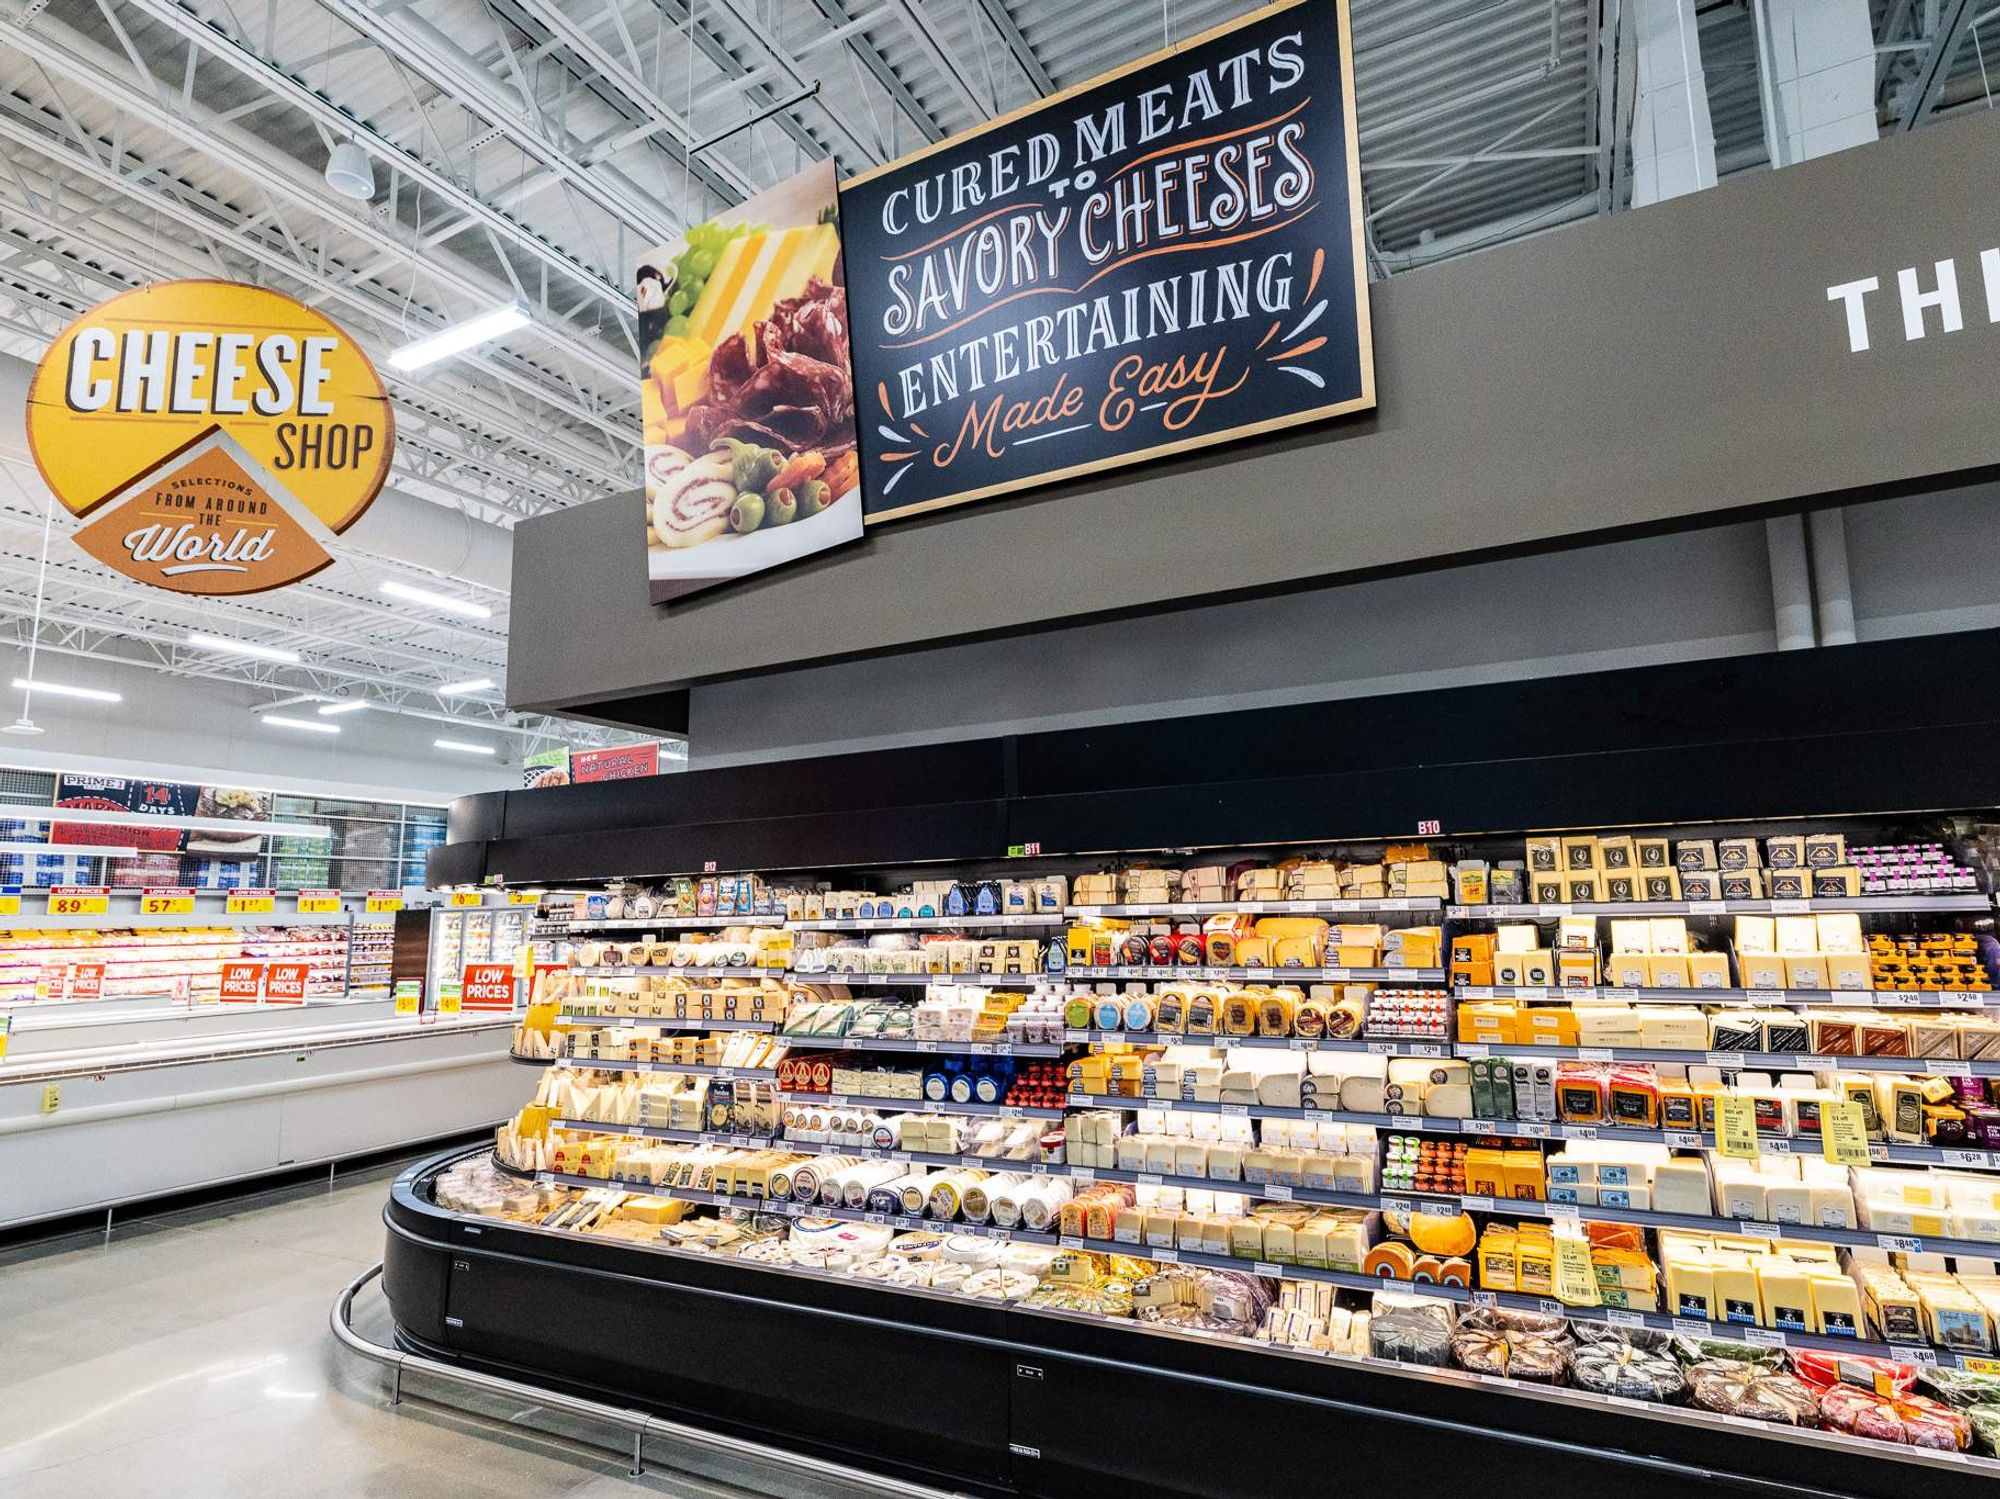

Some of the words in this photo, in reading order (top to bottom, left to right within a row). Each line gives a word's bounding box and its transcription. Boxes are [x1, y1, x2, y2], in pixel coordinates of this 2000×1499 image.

[882, 132, 1061, 236] CURED
[1073, 31, 1305, 169] MEATS
[1048, 169, 1097, 200] TO
[882, 206, 1072, 337] SAVORY
[1079, 121, 1315, 265] CHEESES
[898, 251, 1294, 419] ENTERTAINING
[65, 327, 338, 417] CHEESE
[932, 373, 1084, 468] Made
[1098, 346, 1252, 432] Easy
[274, 423, 374, 471] SHOP
[171, 477, 254, 497] SELECTIONS
[155, 493, 195, 510] FROM
[205, 497, 267, 515] AROUND
[199, 512, 222, 527] THE
[122, 522, 275, 563] World
[581, 755, 633, 774] NATURAL
[602, 763, 648, 781] CHICKEN
[66, 775, 115, 788] PRIME
[144, 785, 171, 804] 14
[139, 803, 175, 815] DAYS
[1418, 820, 1440, 835] B10
[1025, 842, 1041, 856] B11
[81, 967, 98, 978] LOW
[230, 968, 253, 980] LOW
[275, 968, 299, 980] LOW
[474, 969, 504, 983] LOW
[75, 979, 100, 990] PRICES
[223, 980, 257, 993] PRICES
[268, 980, 302, 993] PRICES
[466, 984, 510, 999] PRICES
